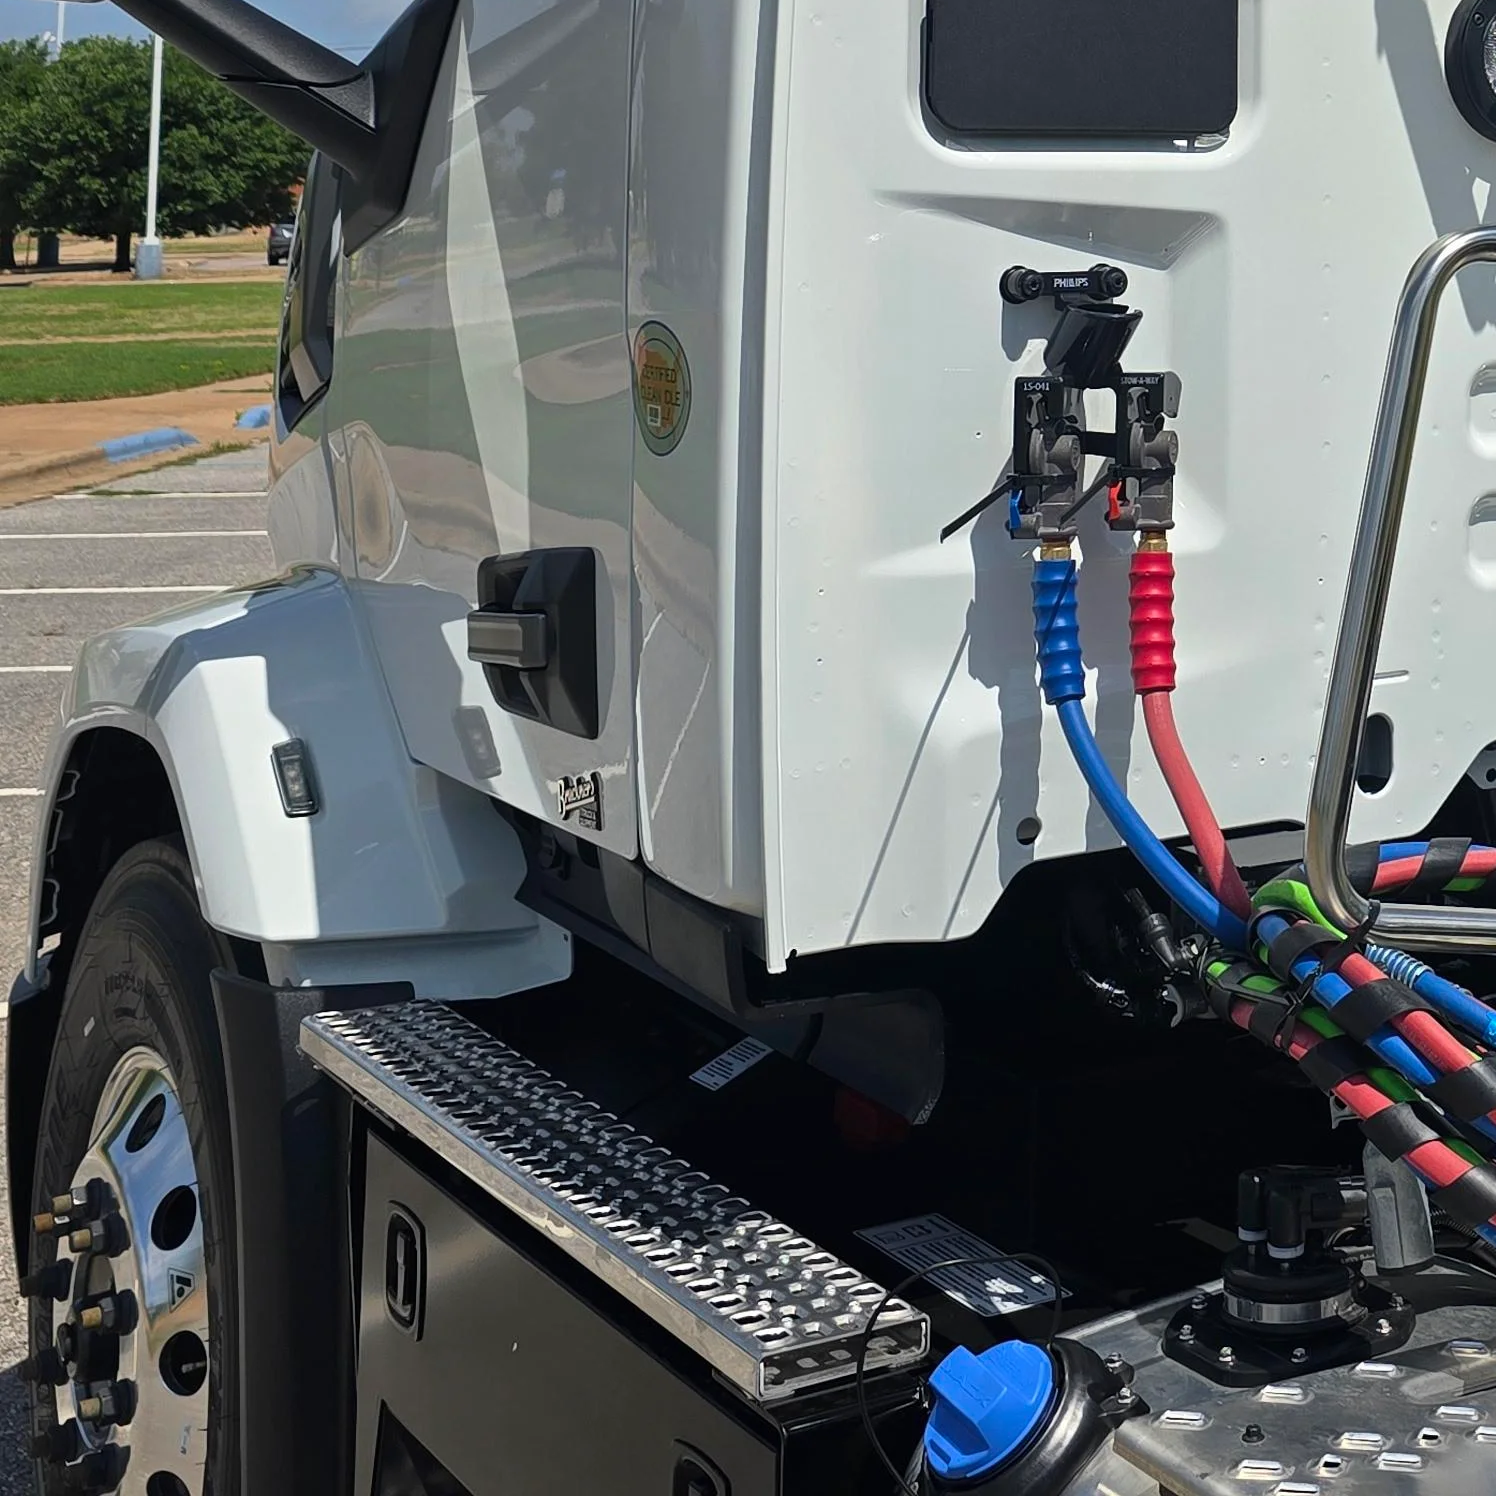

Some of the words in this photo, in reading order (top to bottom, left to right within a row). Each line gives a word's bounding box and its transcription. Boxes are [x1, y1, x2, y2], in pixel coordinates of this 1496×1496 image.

[1053, 277, 1089, 288] PHILLIPS
[641, 364, 677, 384] CERTIFIED
[663, 389, 681, 406] DLE
